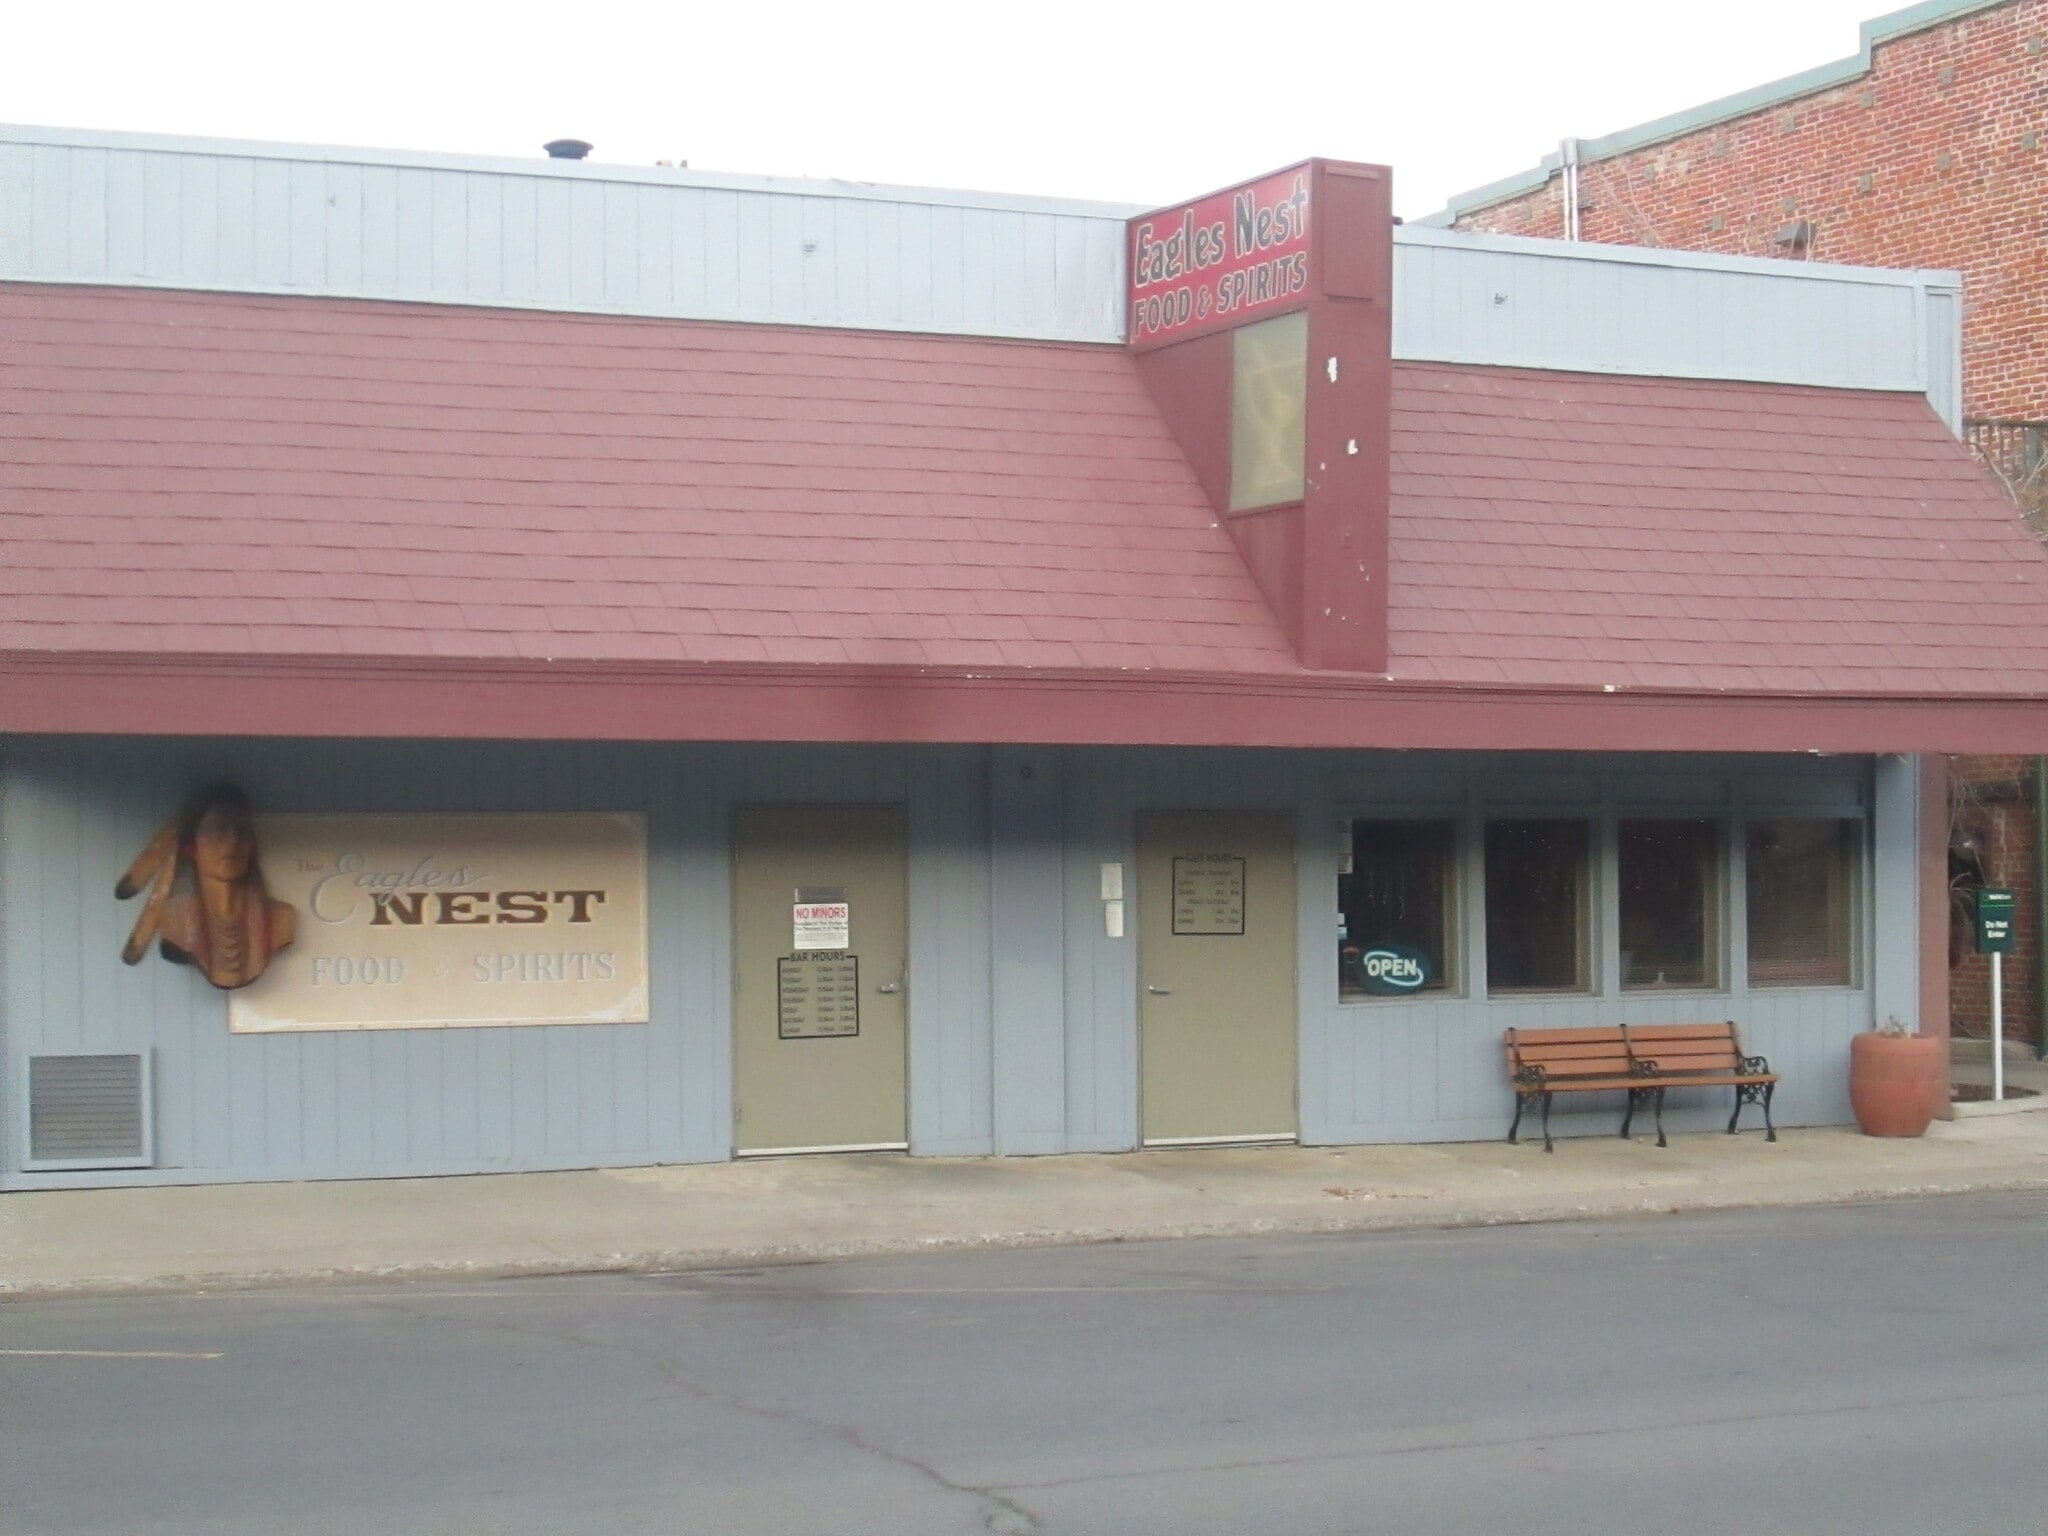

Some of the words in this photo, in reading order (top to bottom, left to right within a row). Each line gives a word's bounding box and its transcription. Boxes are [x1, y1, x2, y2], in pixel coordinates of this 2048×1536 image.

[1134, 208, 1225, 288] Eagles
[1234, 175, 1308, 259] Nest
[1132, 286, 1192, 338] FOOD
[1217, 251, 1307, 314] SPIRITS
[298, 857, 324, 872] The
[310, 853, 489, 925] Eagles
[368, 890, 606, 926] NEST
[796, 908, 810, 920] NO
[812, 907, 847, 919] MINORS
[1987, 930, 2006, 938] Enter
[311, 955, 408, 988] FOOD
[473, 951, 616, 984] SPIRITS
[790, 952, 809, 962] BAR
[812, 951, 845, 961] HOURS
[1367, 958, 1417, 977] OPEN
